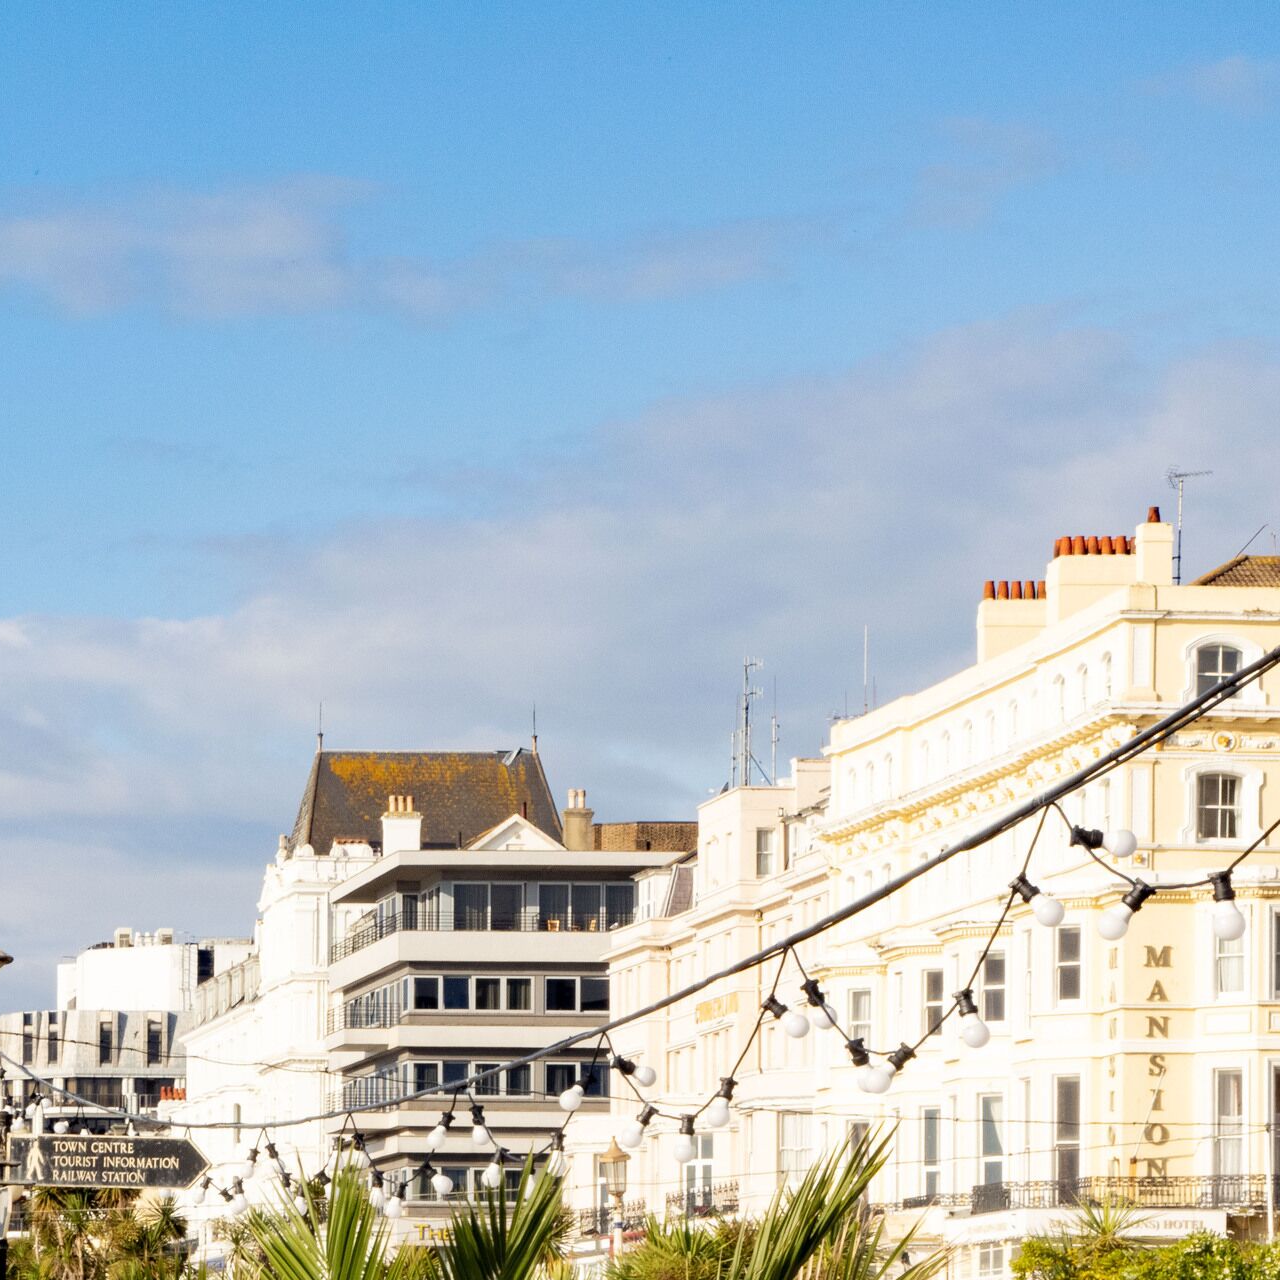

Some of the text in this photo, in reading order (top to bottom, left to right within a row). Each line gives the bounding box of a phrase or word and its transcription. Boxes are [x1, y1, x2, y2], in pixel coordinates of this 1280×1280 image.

[1144, 945, 1173, 1180] MANSION
[53, 1141, 134, 1154] TOWN CENTRE
[52, 1155, 180, 1169] TOURIST INFORMATION
[52, 1169, 146, 1184] RAILWAY STATION
[1163, 1220, 1205, 1231] HOTEL
